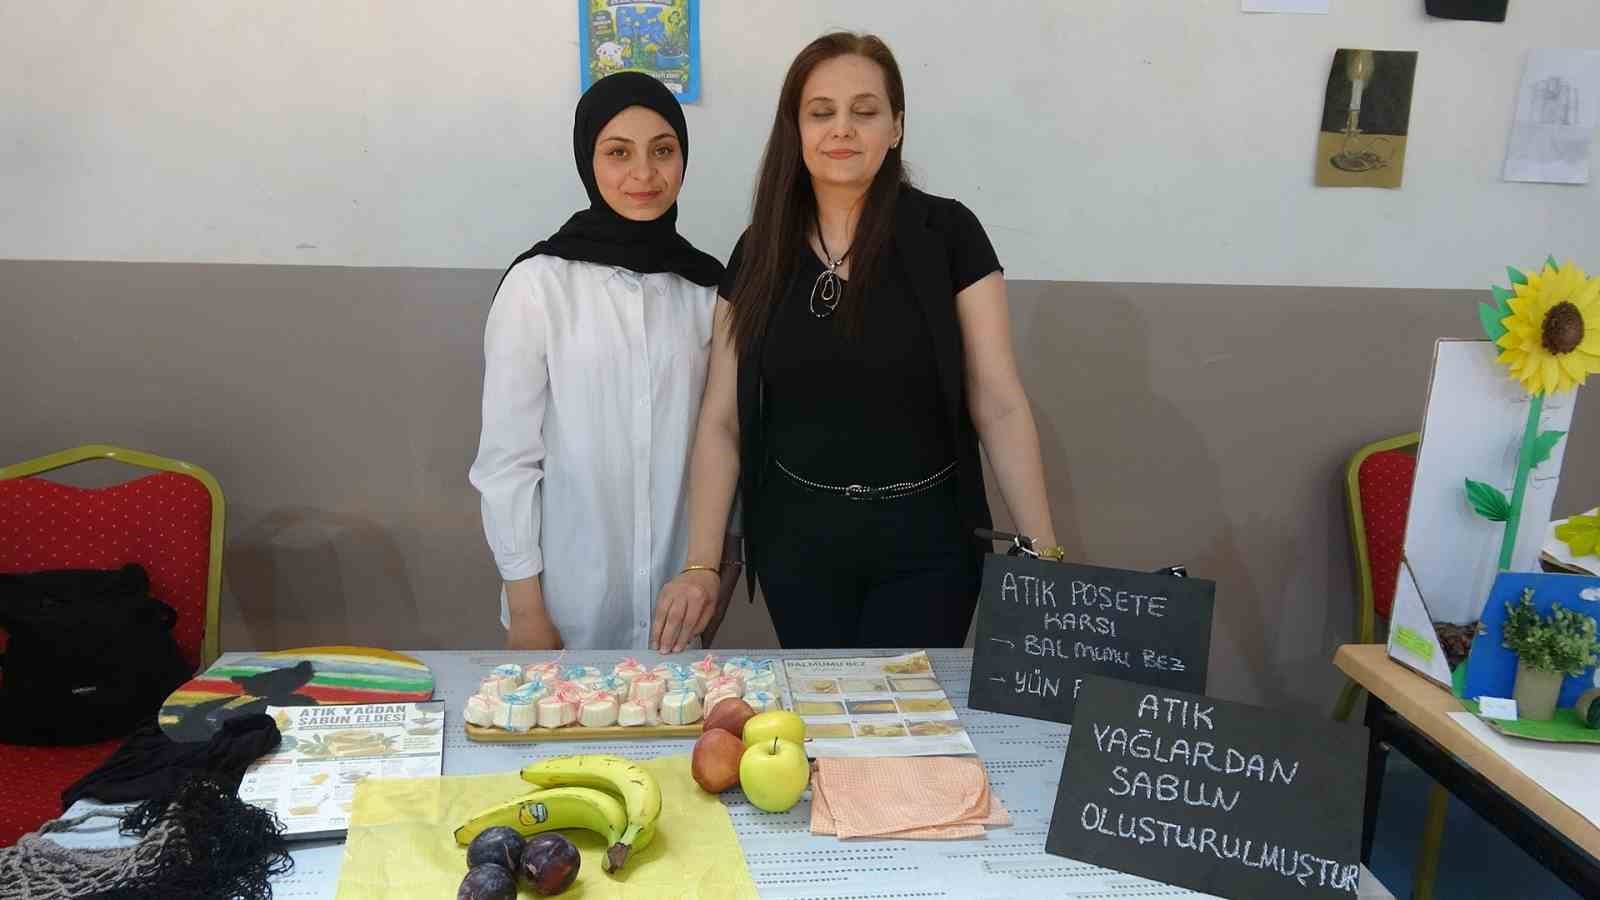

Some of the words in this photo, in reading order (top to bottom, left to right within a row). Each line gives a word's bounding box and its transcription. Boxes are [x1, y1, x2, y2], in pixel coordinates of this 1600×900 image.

[1001, 572, 1057, 608] ATIK
[1071, 580, 1168, 617] POŞETE
[1142, 648, 1186, 672] BEZ
[1015, 668, 1060, 697] YÜN
[298, 715, 351, 725] SABUN
[299, 706, 338, 717] ATIK
[343, 704, 407, 716] YAĞDAN
[1138, 693, 1216, 731] ATIK
[1093, 723, 1300, 785] YAĞLARDAN
[1108, 765, 1241, 812] SABUN
[1080, 802, 1360, 895] OLUŞTURULMUŞTUR
